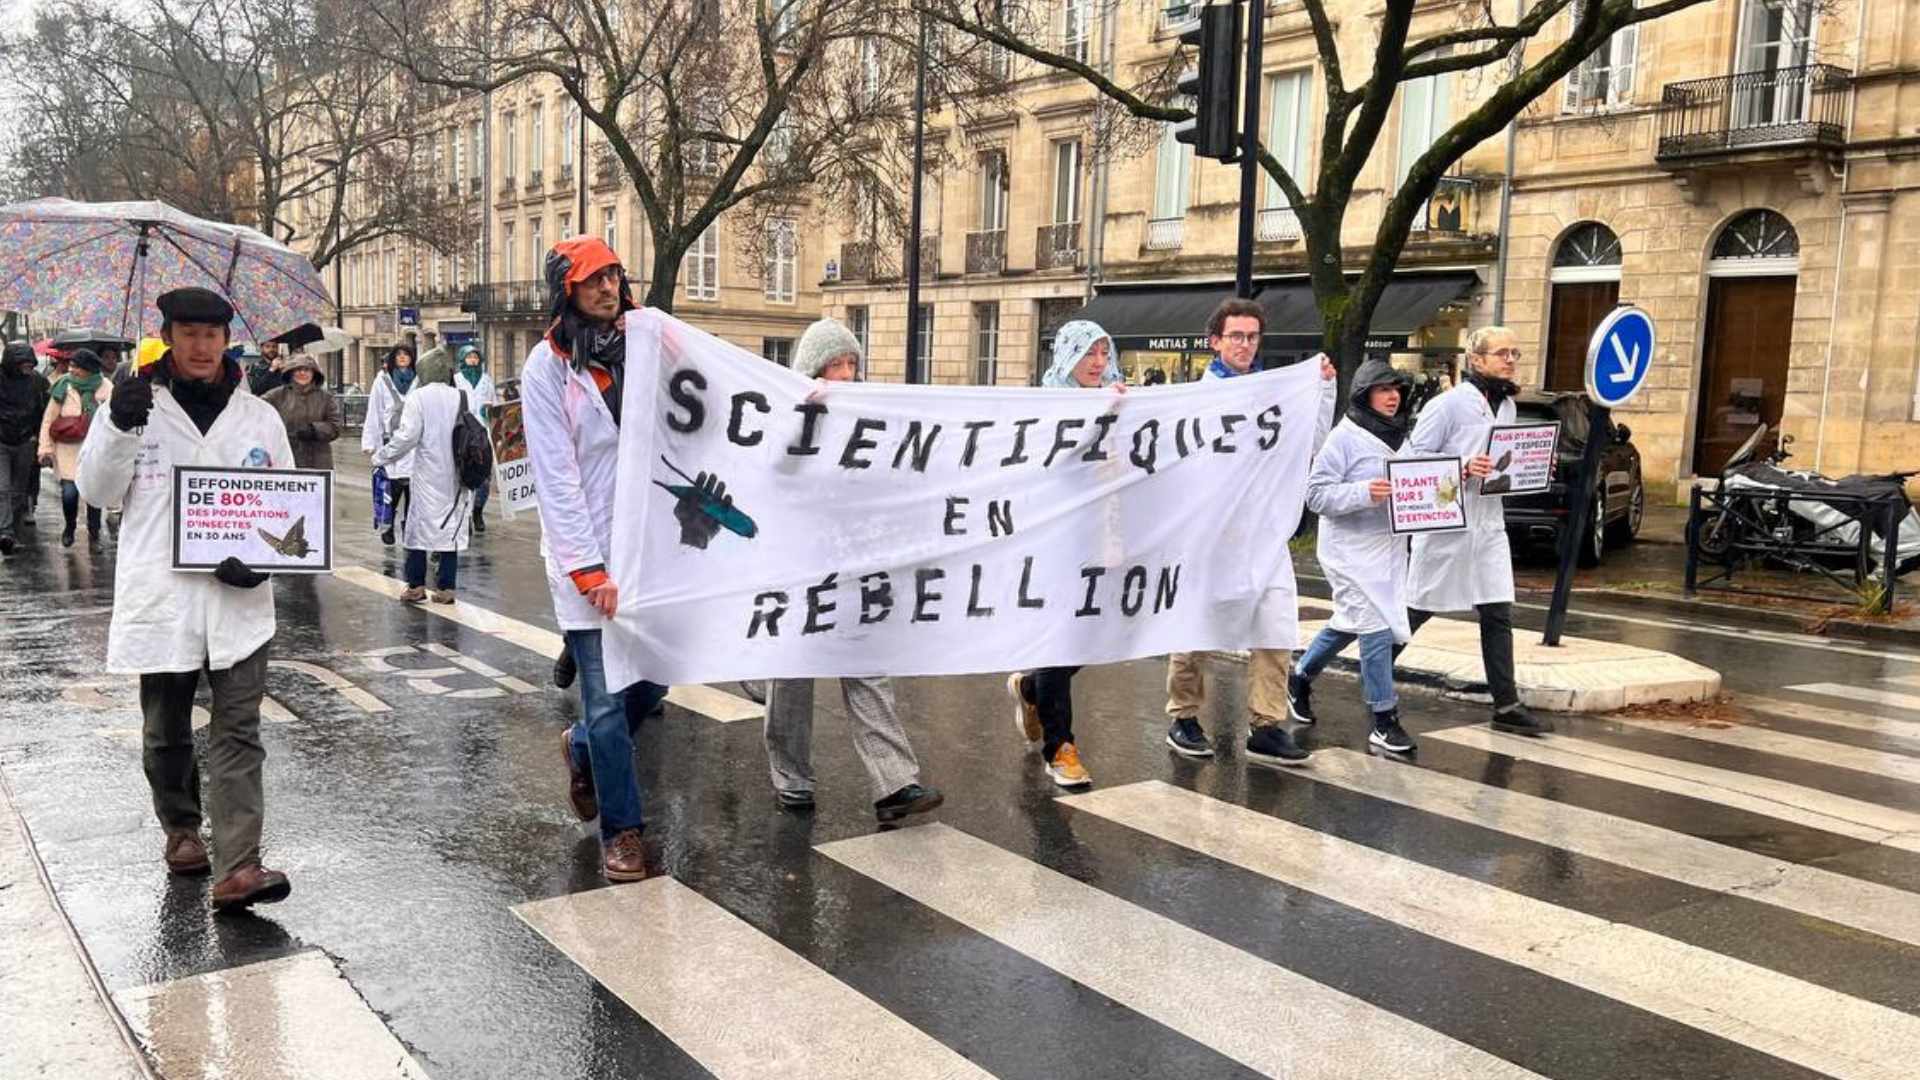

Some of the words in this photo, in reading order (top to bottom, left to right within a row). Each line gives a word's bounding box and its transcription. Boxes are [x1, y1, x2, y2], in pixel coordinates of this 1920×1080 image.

[1149, 338, 1188, 349] MATIAS
[667, 369, 1282, 474] SCIENTIFIQUES
[500, 463, 531, 480] IODI
[188, 478, 317, 492] EFFONDREMENT
[1401, 476, 1439, 488] PLANTE
[188, 492, 215, 505] DE
[221, 493, 262, 506] 80%
[1396, 491, 1416, 502] SUR
[187, 509, 209, 517] DES
[212, 509, 289, 518] POPULATIONS
[943, 496, 1012, 537] EN
[187, 520, 252, 529] D'INSECTES
[187, 532, 202, 540] EN
[206, 532, 219, 540] 30
[222, 532, 246, 540] ANS
[746, 556, 1181, 638] RÉBELLION
